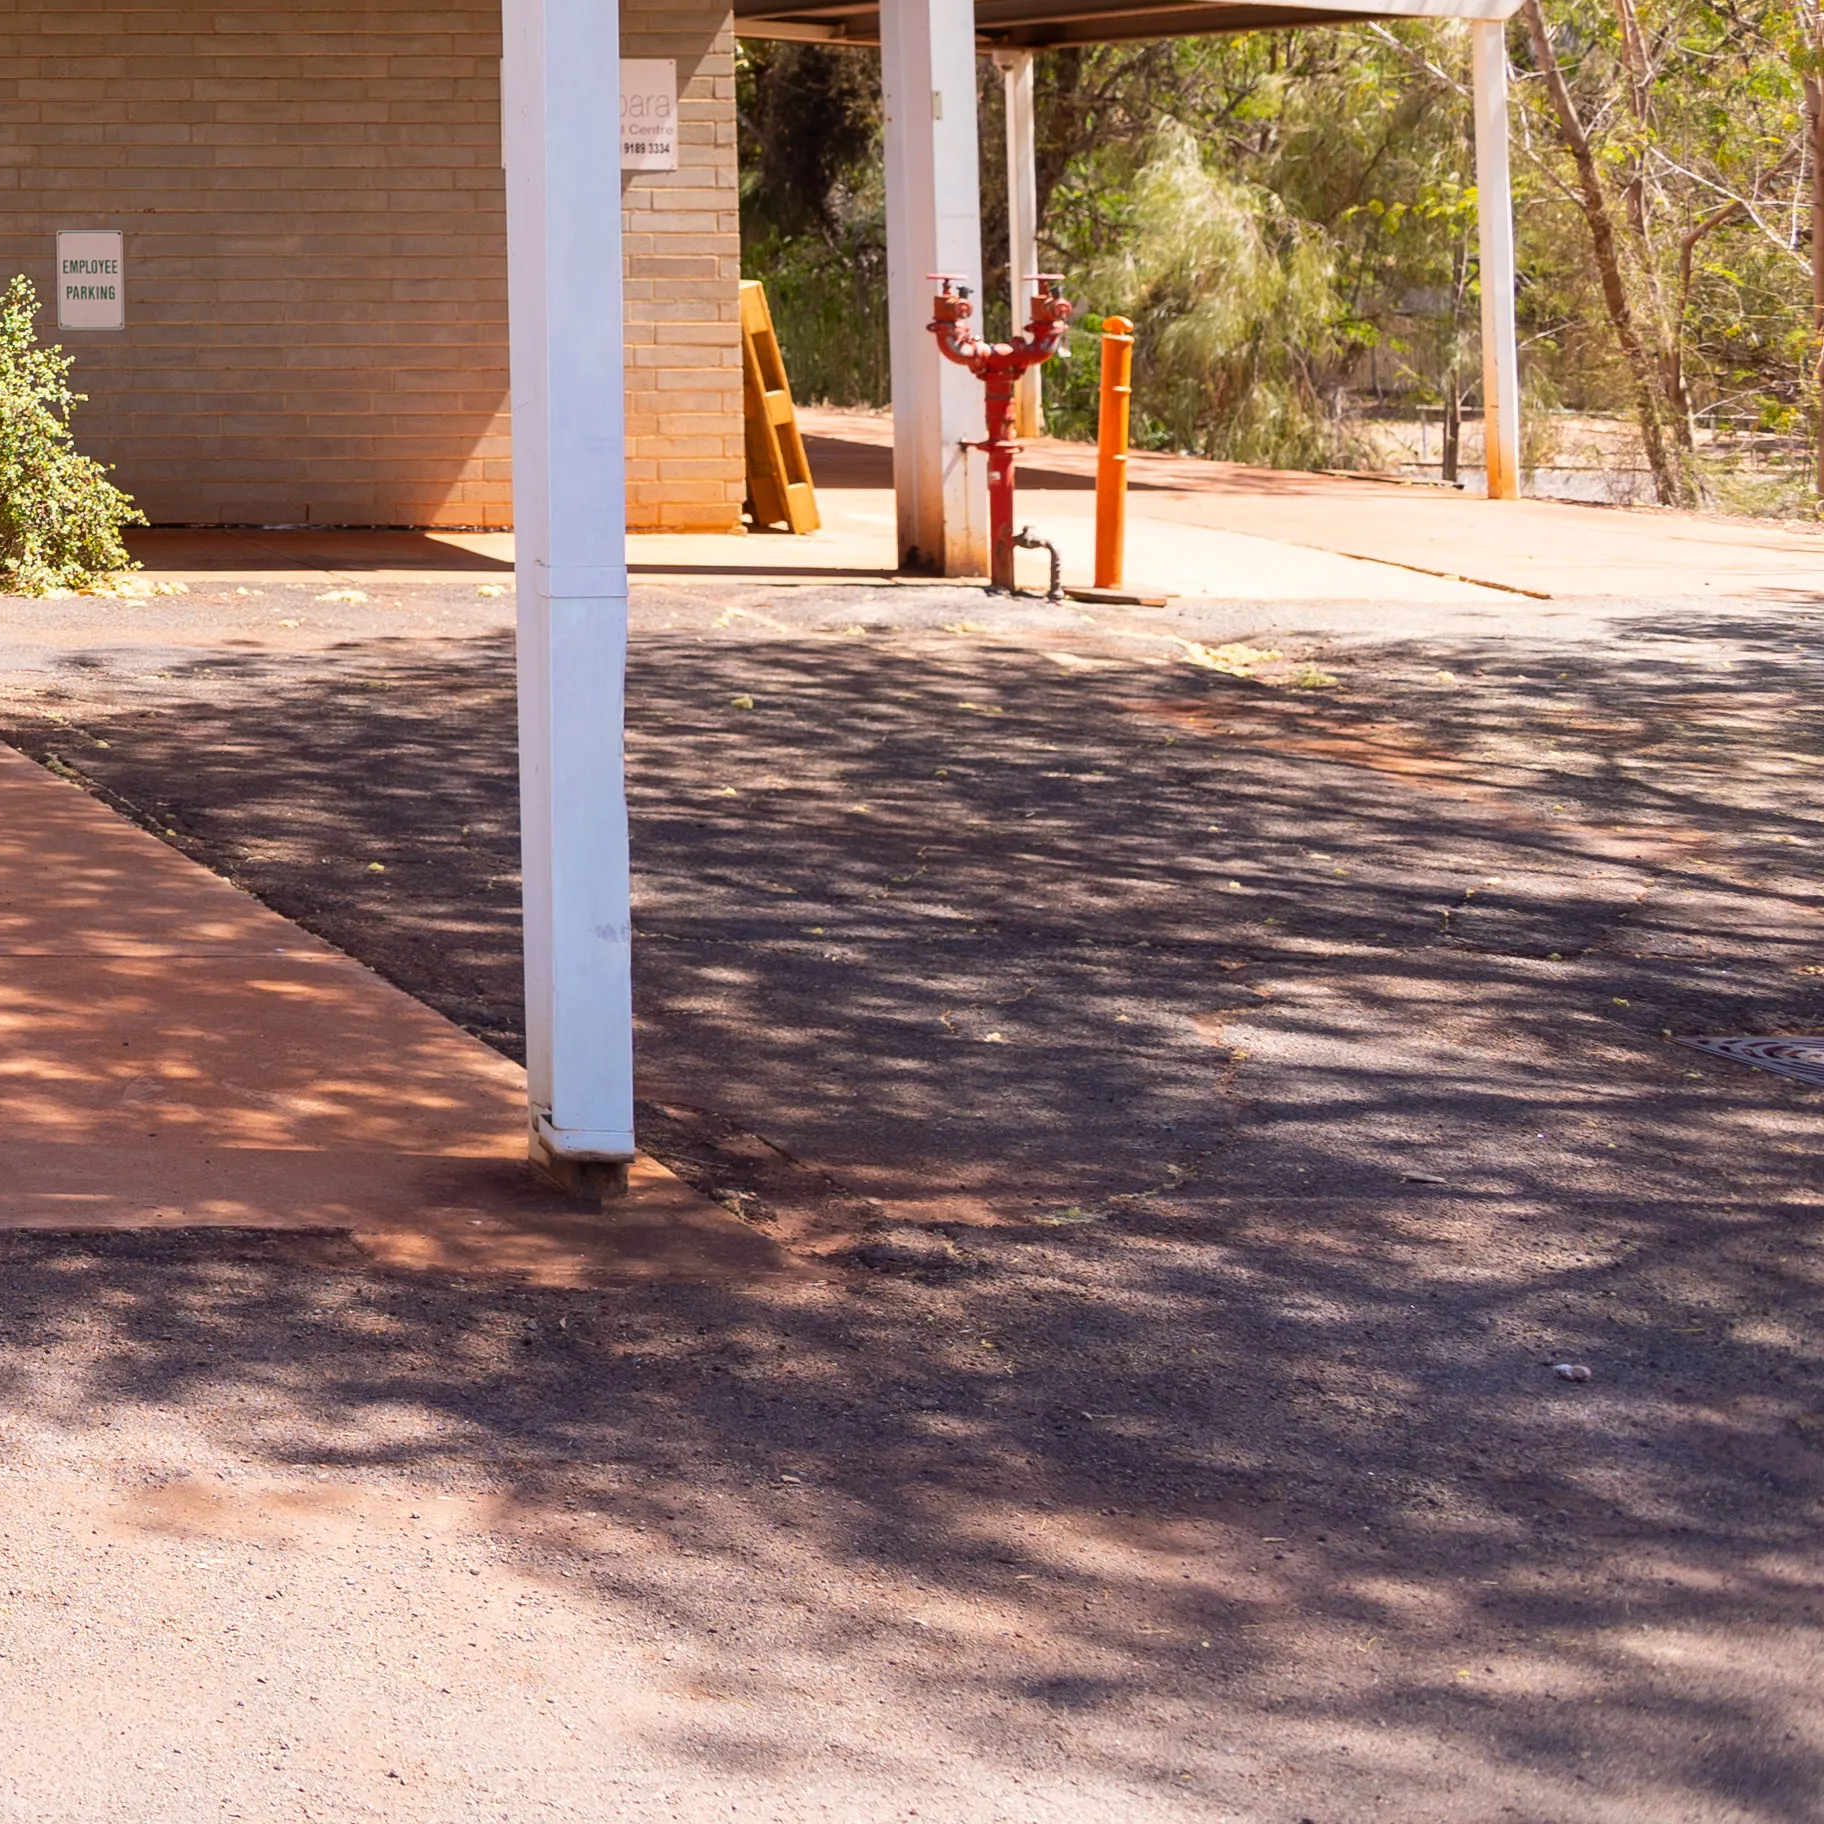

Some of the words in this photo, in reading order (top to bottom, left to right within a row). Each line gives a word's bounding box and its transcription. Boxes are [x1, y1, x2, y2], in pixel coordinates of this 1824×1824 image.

[623, 142, 646, 154] 9189
[62, 260, 119, 274] EMPLOYEE
[66, 285, 116, 300] PARKING
